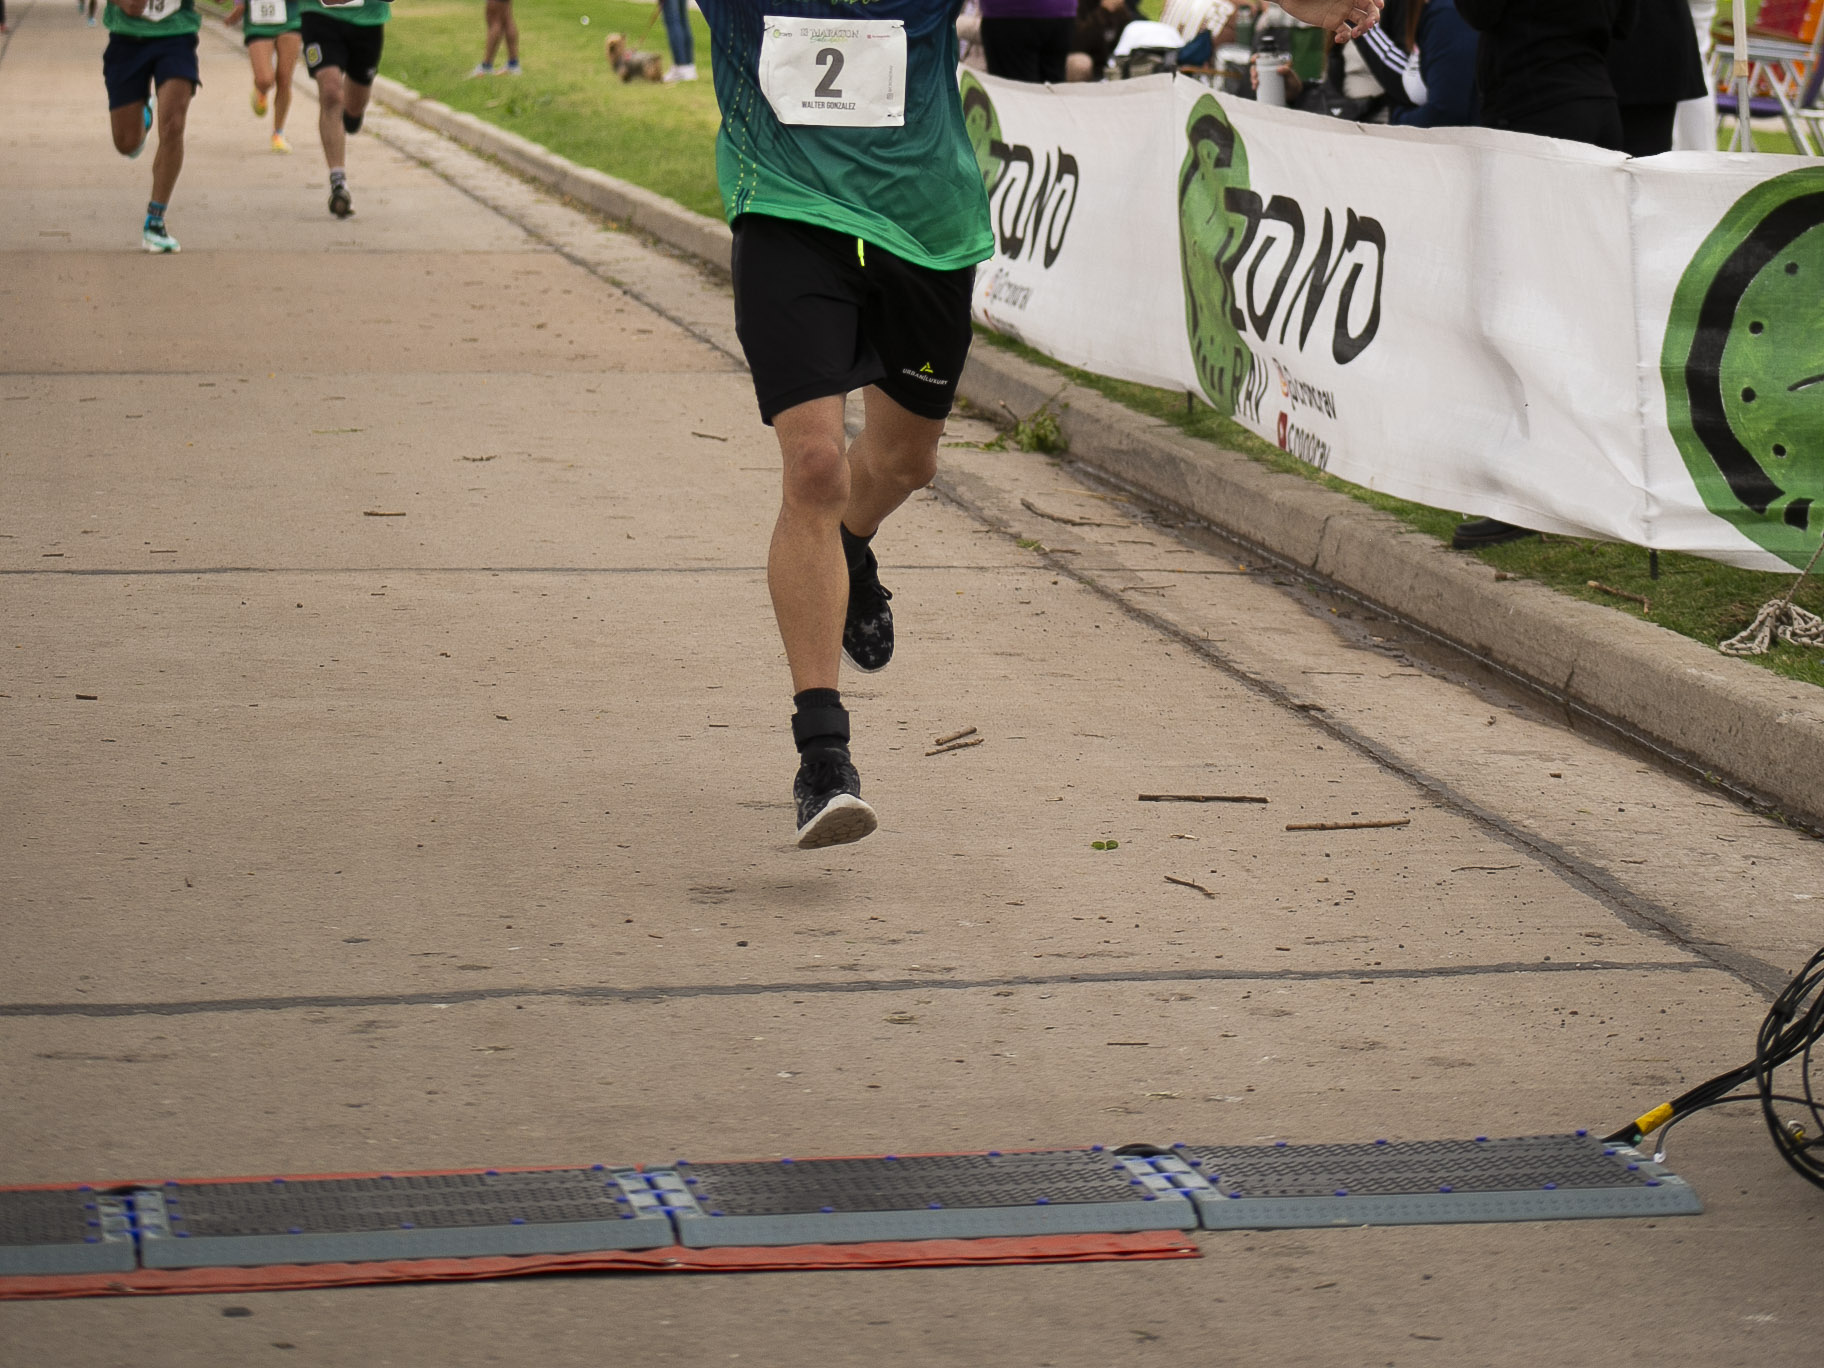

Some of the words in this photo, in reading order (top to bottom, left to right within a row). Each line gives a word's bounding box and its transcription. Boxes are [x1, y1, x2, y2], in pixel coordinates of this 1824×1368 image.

[815, 47, 845, 99] 2
[801, 100, 826, 110] WALTER
[826, 101, 856, 111] GONZALEZ
